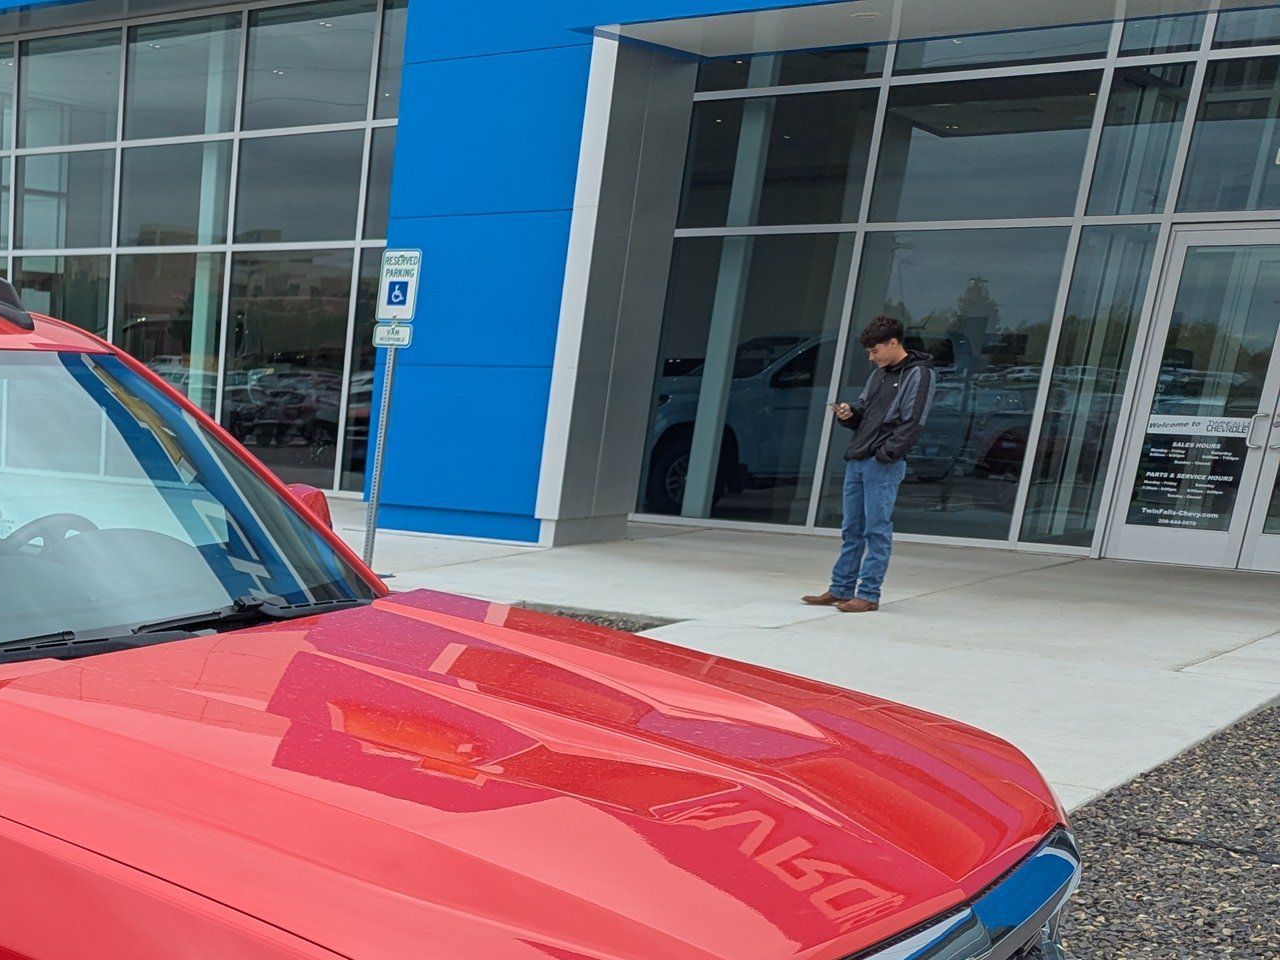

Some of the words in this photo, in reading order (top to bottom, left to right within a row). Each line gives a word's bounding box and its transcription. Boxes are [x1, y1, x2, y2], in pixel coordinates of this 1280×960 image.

[385, 256, 418, 266] RESERVED
[385, 268, 415, 278] PARKING
[387, 328, 400, 336] VAN
[1149, 421, 1190, 429] Welcome
[1141, 507, 1219, 519] TwinFalls-Chevy.com
